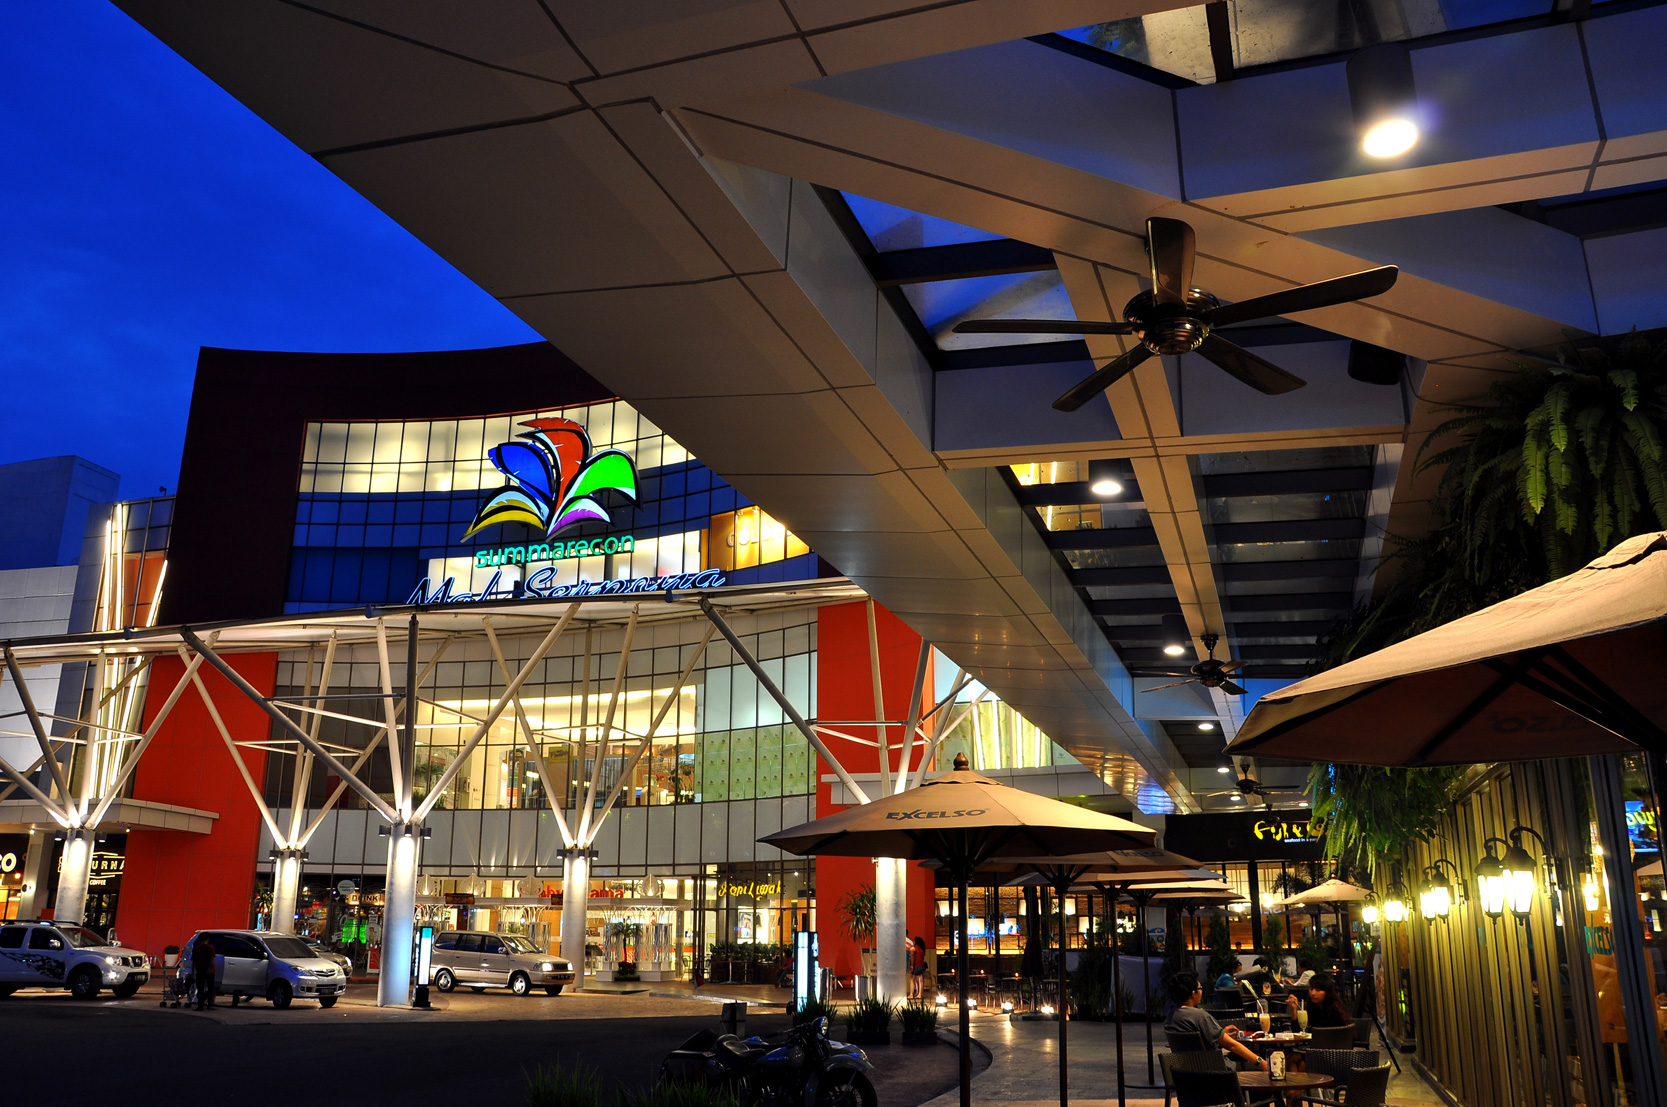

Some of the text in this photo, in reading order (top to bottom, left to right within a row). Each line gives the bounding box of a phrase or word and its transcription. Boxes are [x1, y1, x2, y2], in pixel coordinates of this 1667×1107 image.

[475, 534, 634, 568] summarecon
[406, 568, 503, 604] Mal
[886, 808, 986, 821] EXCELSO
[1253, 820, 1289, 841] Fish
[1292, 823, 1304, 838] &
[0, 852, 17, 872] O
[91, 860, 125, 870] URNA
[588, 889, 624, 898] ama
[1584, 914, 1616, 960] EXCELS
